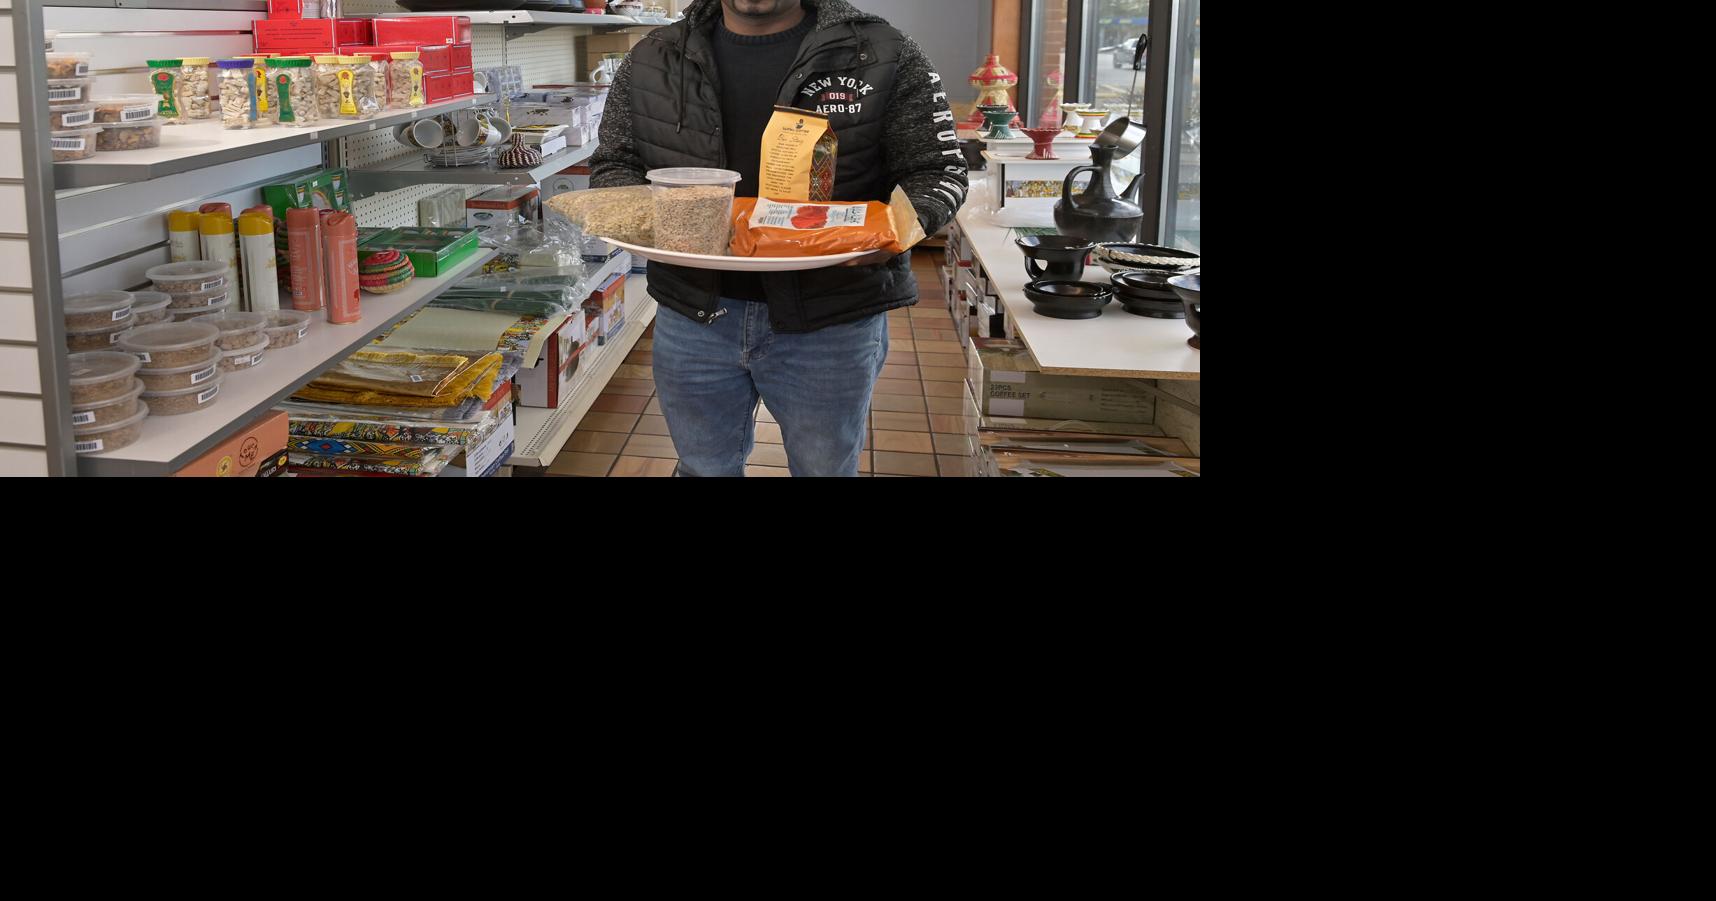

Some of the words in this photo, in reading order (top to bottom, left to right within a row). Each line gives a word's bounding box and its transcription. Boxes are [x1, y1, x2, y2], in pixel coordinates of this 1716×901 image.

[801, 77, 832, 97] NEW
[815, 103, 862, 115] AERO-87
[990, 391, 1016, 399] COFFEE
